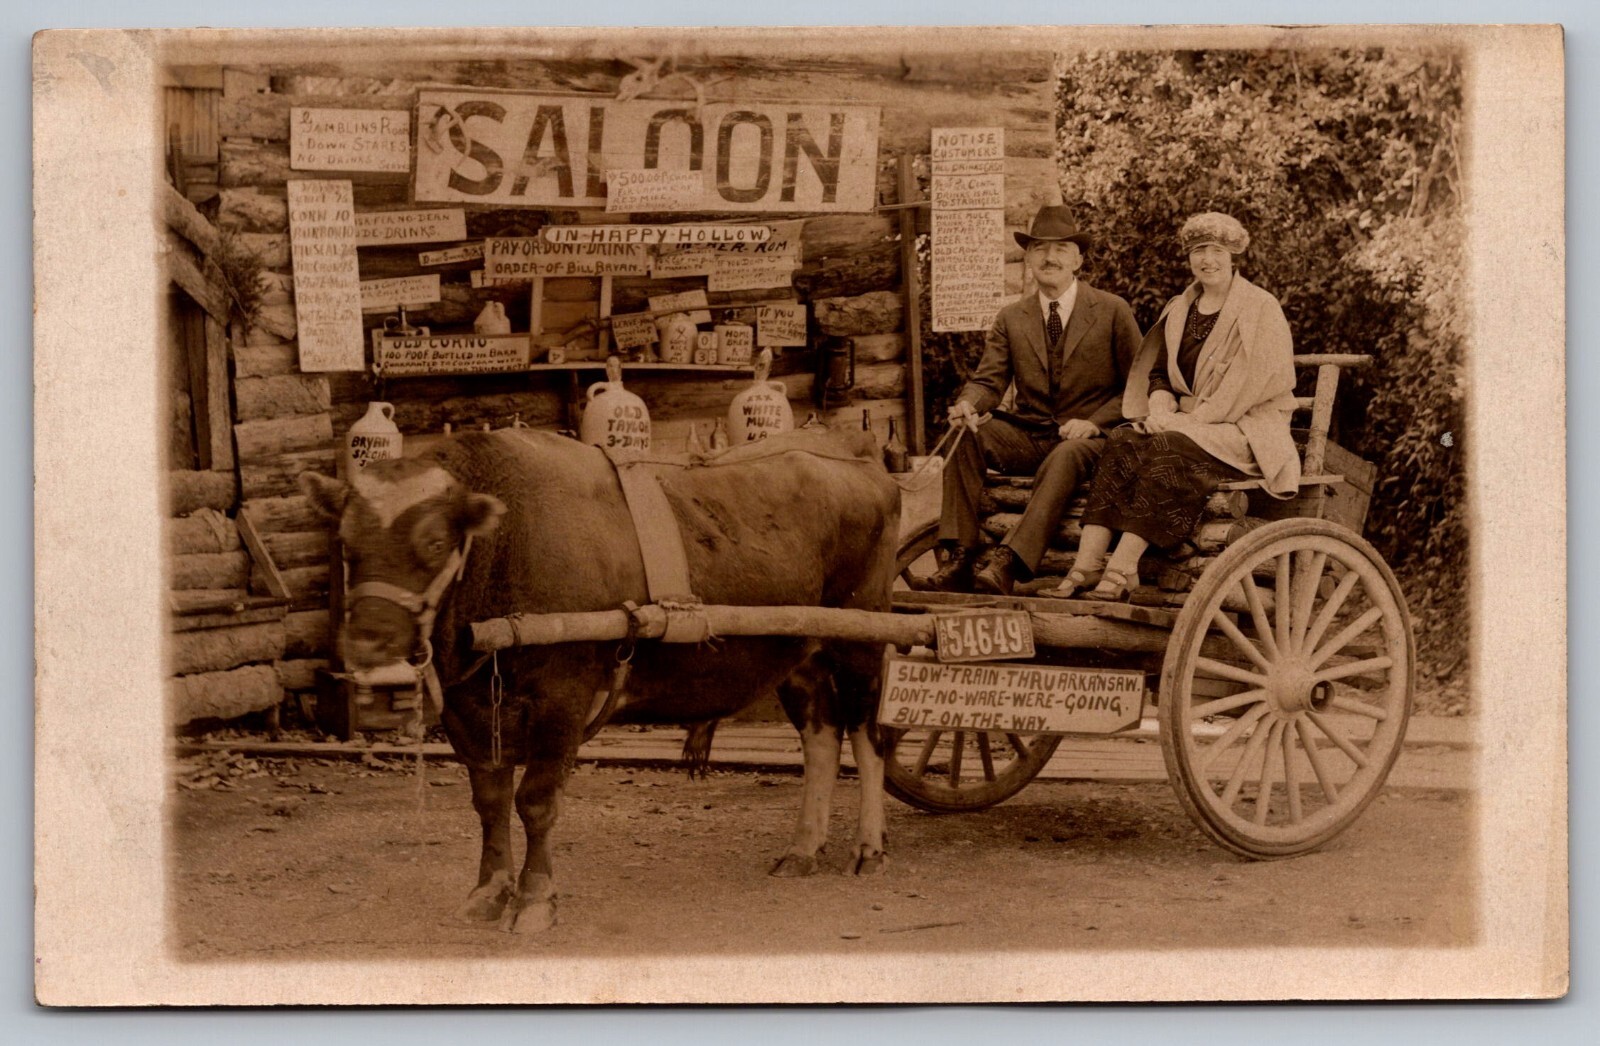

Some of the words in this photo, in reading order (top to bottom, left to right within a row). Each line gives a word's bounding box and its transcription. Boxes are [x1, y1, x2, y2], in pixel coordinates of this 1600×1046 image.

[938, 133, 996, 147] NOTISE
[448, 101, 844, 204] SALOON
[760, 308, 771, 318] IF
[774, 309, 794, 319] YOU
[385, 351, 401, 360] 100
[613, 406, 642, 420] OLD
[742, 405, 782, 417] WHITE
[746, 417, 781, 429] MULE
[351, 435, 390, 450] BRYAN
[948, 616, 1022, 656] 54649
